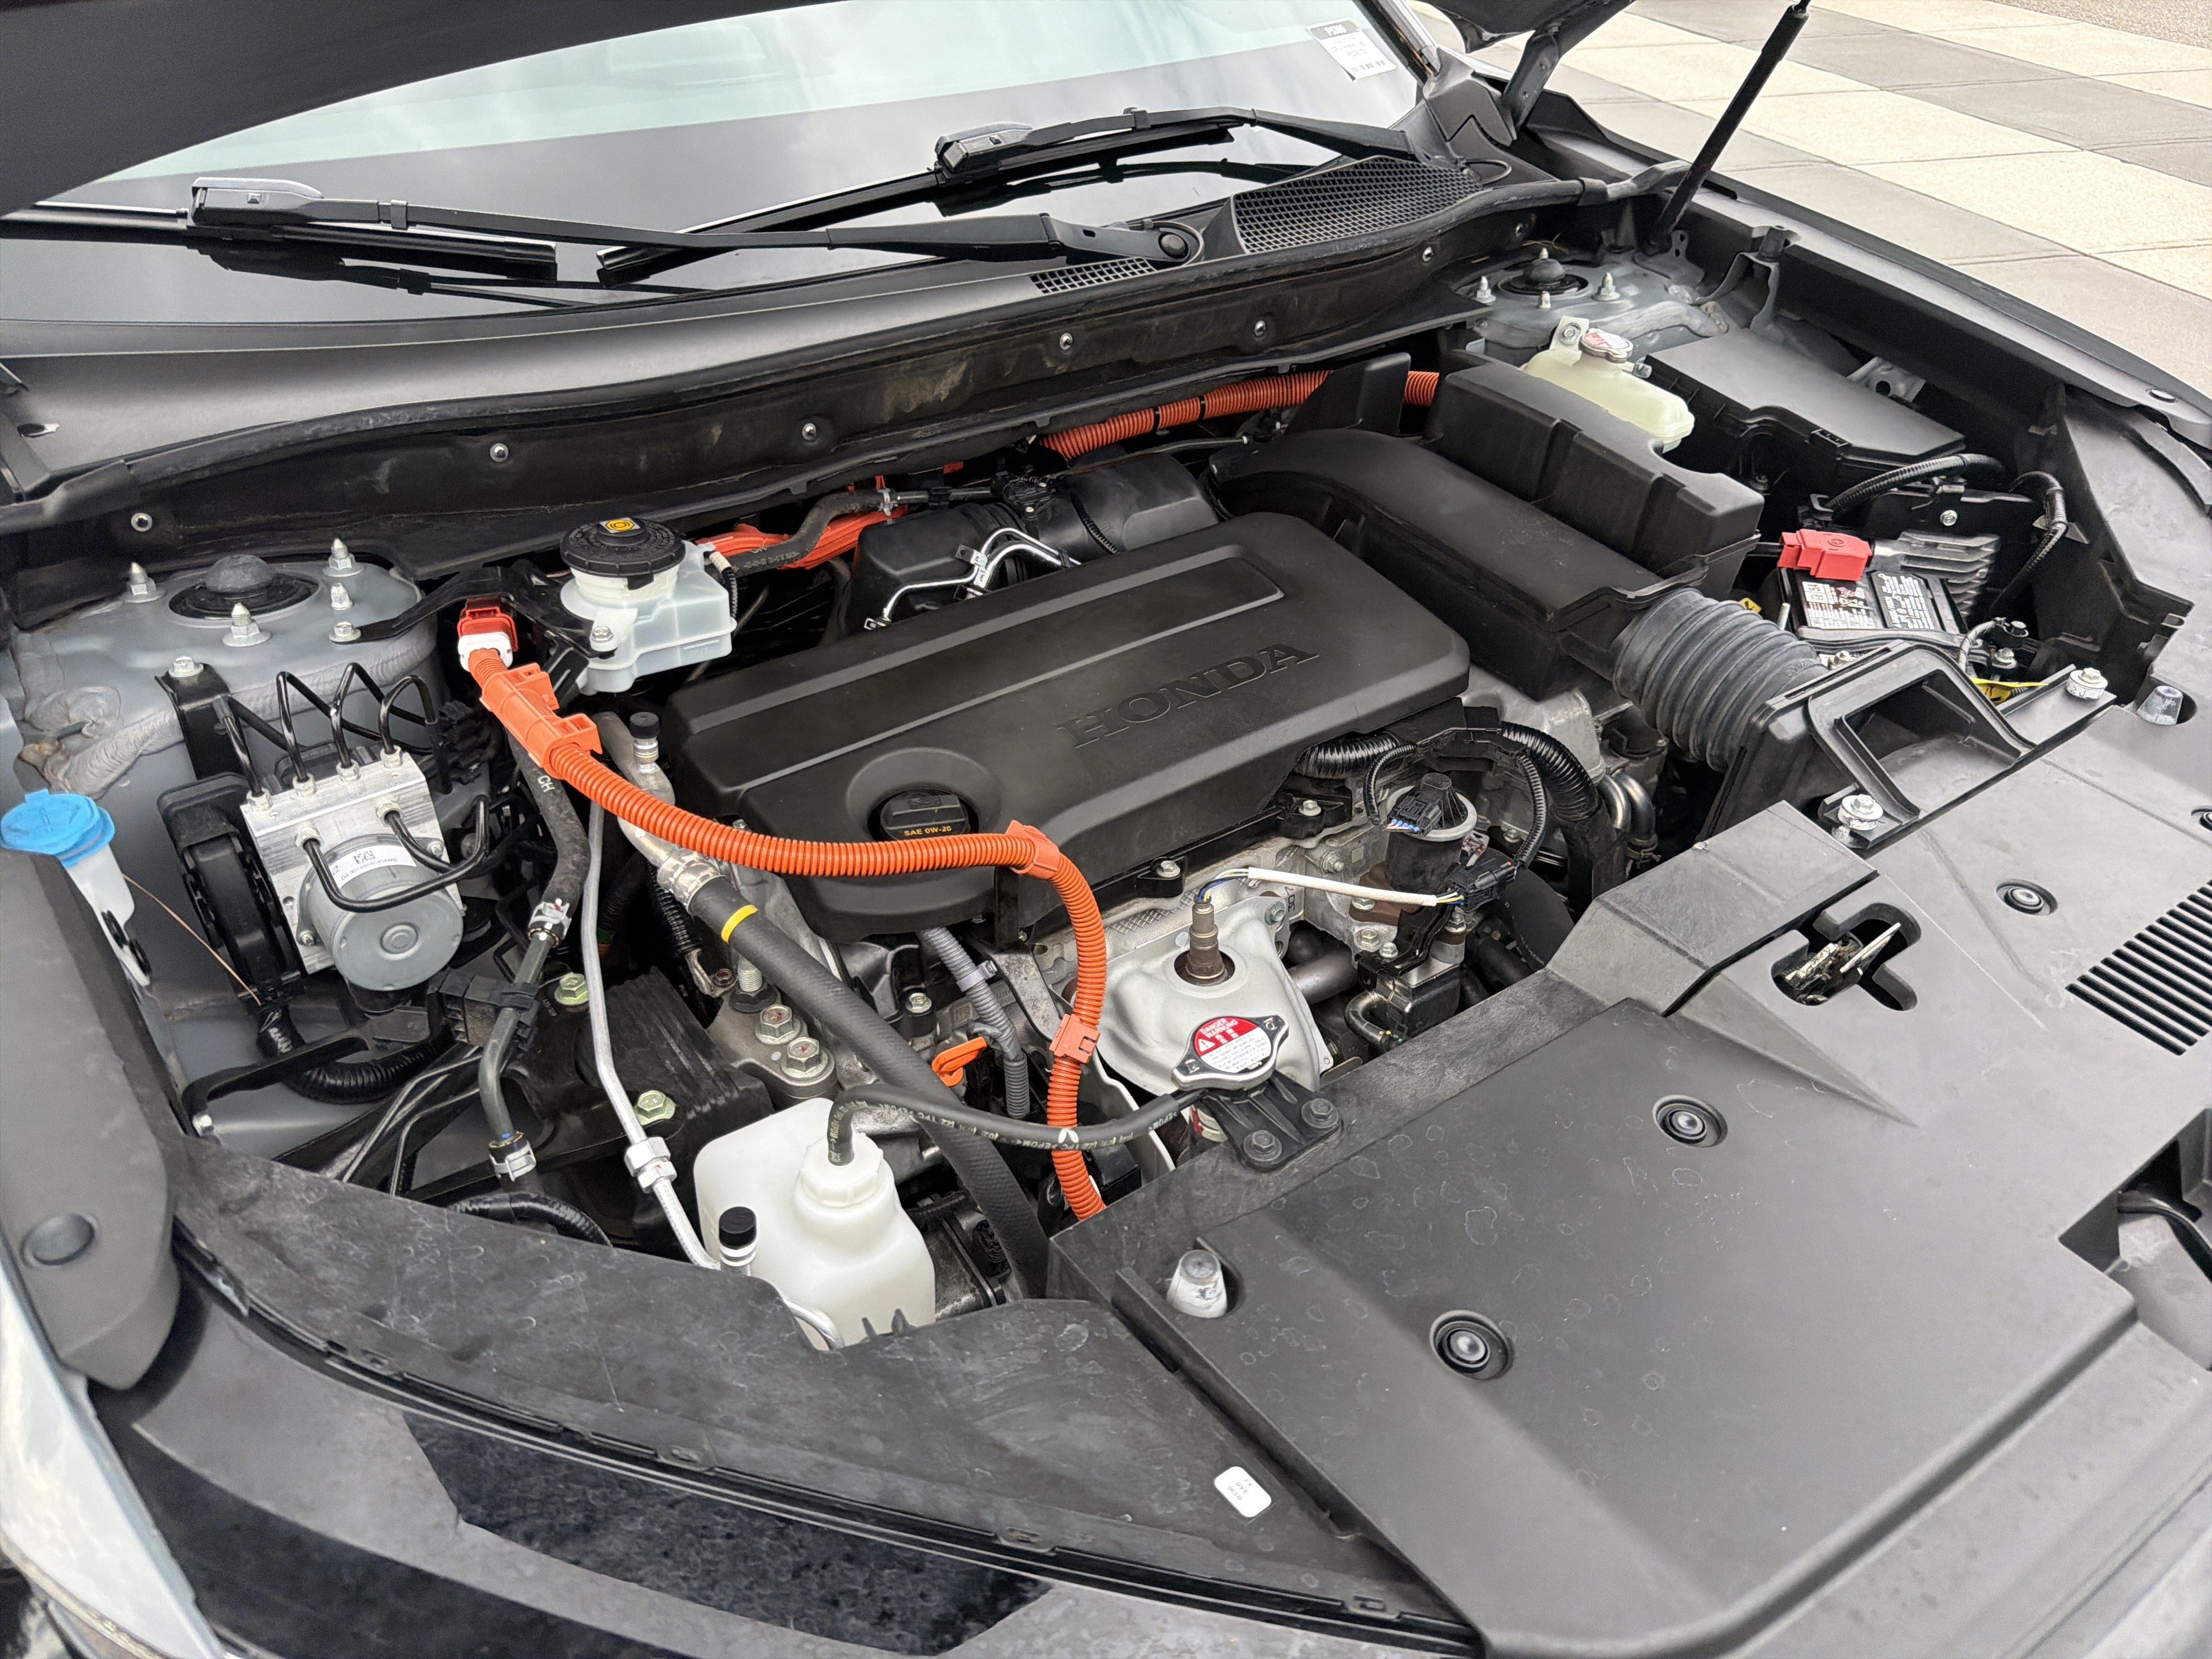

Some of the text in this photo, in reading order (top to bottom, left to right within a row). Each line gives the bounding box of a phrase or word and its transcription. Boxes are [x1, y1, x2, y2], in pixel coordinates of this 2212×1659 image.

[1056, 642, 1320, 749] HONDA
[904, 825, 952, 837] SAE 0W-20
